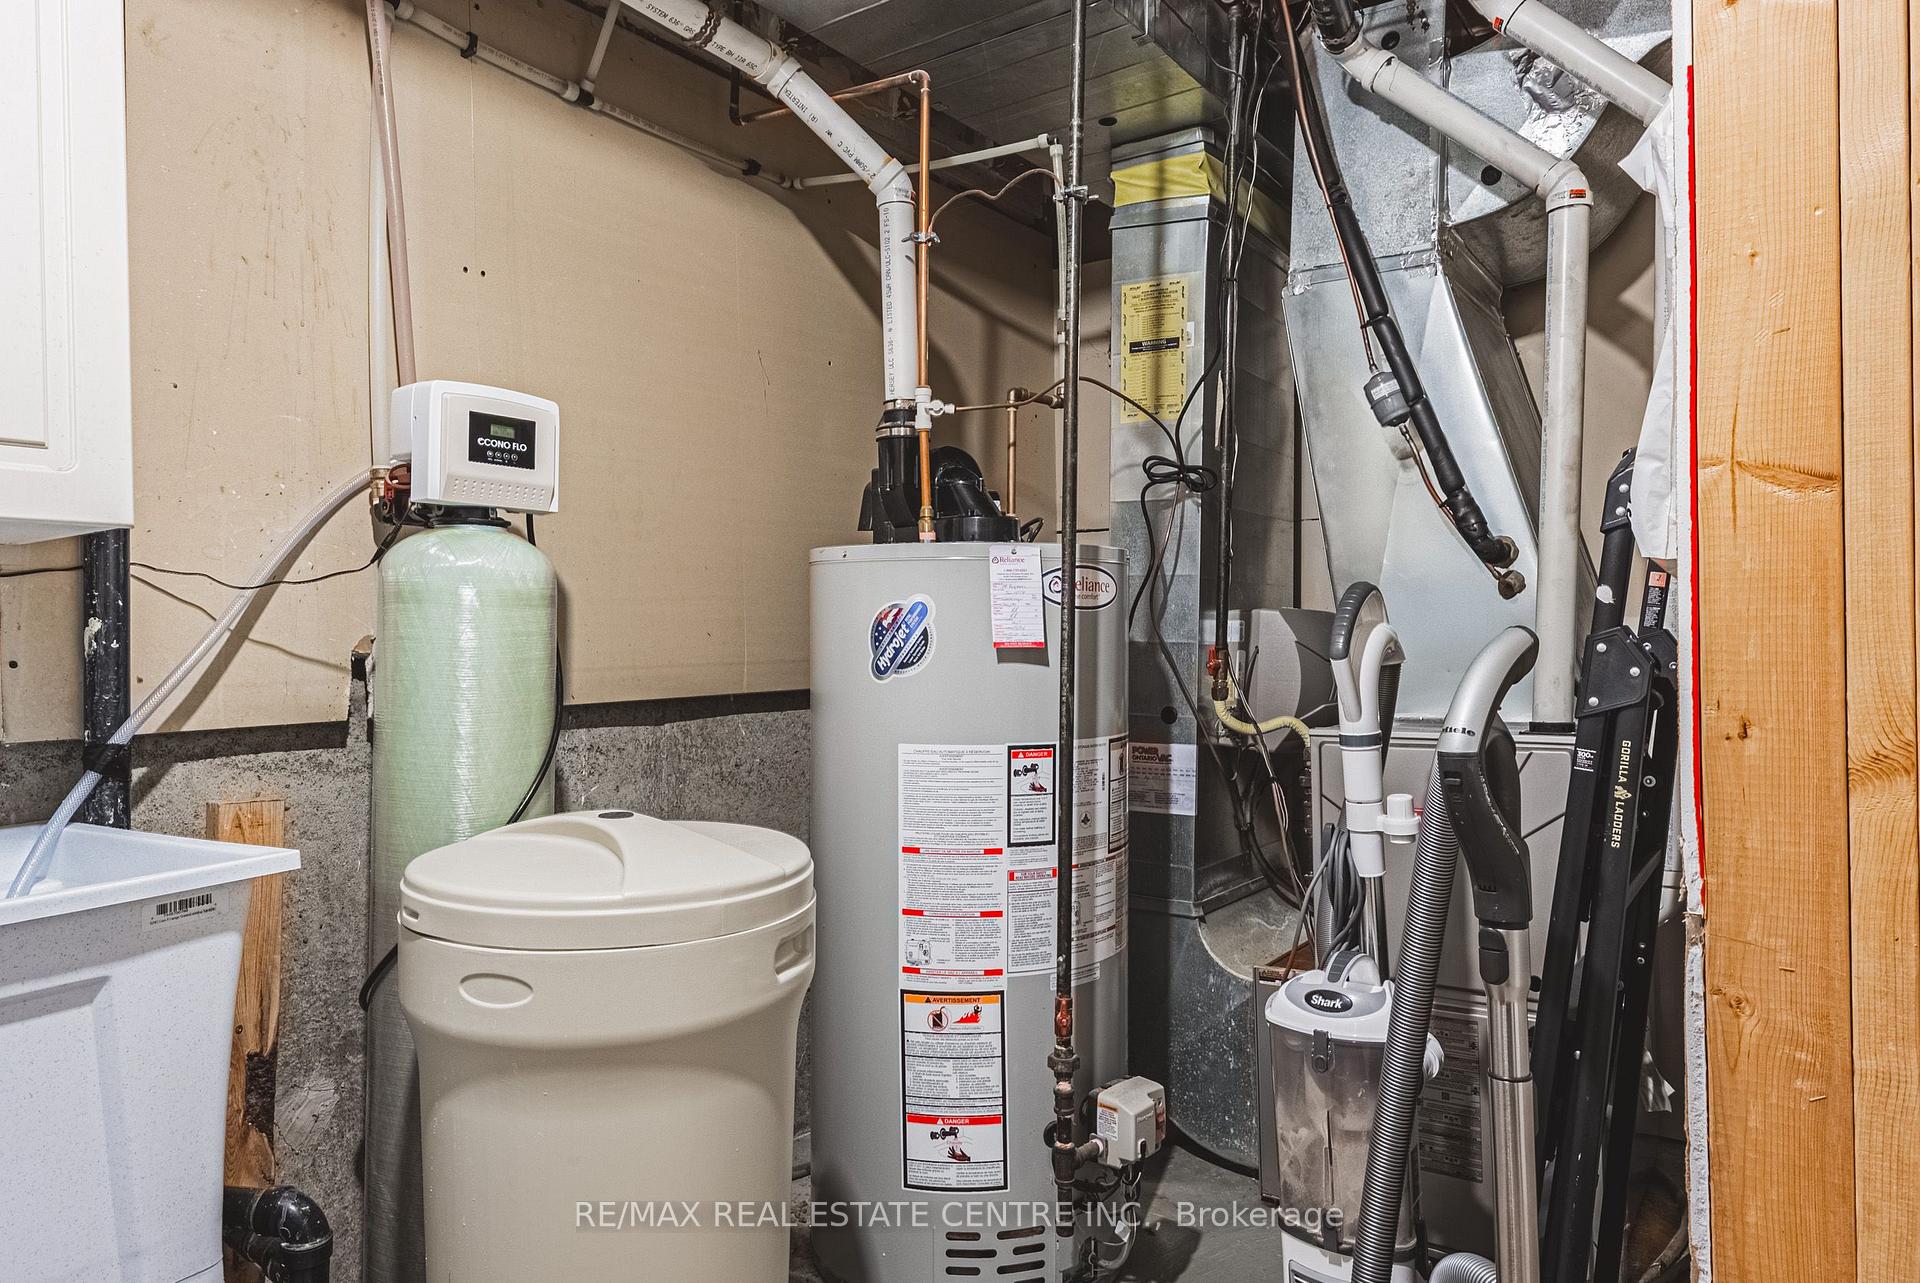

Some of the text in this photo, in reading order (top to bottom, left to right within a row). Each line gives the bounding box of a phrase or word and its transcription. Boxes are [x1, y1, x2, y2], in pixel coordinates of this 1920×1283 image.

[645, 3, 669, 19] SYSTEM
[711, 41, 726, 53] TYPE
[784, 87, 808, 113] INTERTEK
[842, 146, 855, 158] PVC
[512, 442, 528, 452] FLO
[1073, 576, 1110, 593] eliance
[877, 621, 910, 671] Hydrojet
[1131, 746, 1159, 754] POWER
[1618, 740, 1631, 783] GORILLA
[1611, 801, 1625, 848] LADDERS
[1310, 994, 1343, 1009] Shark
